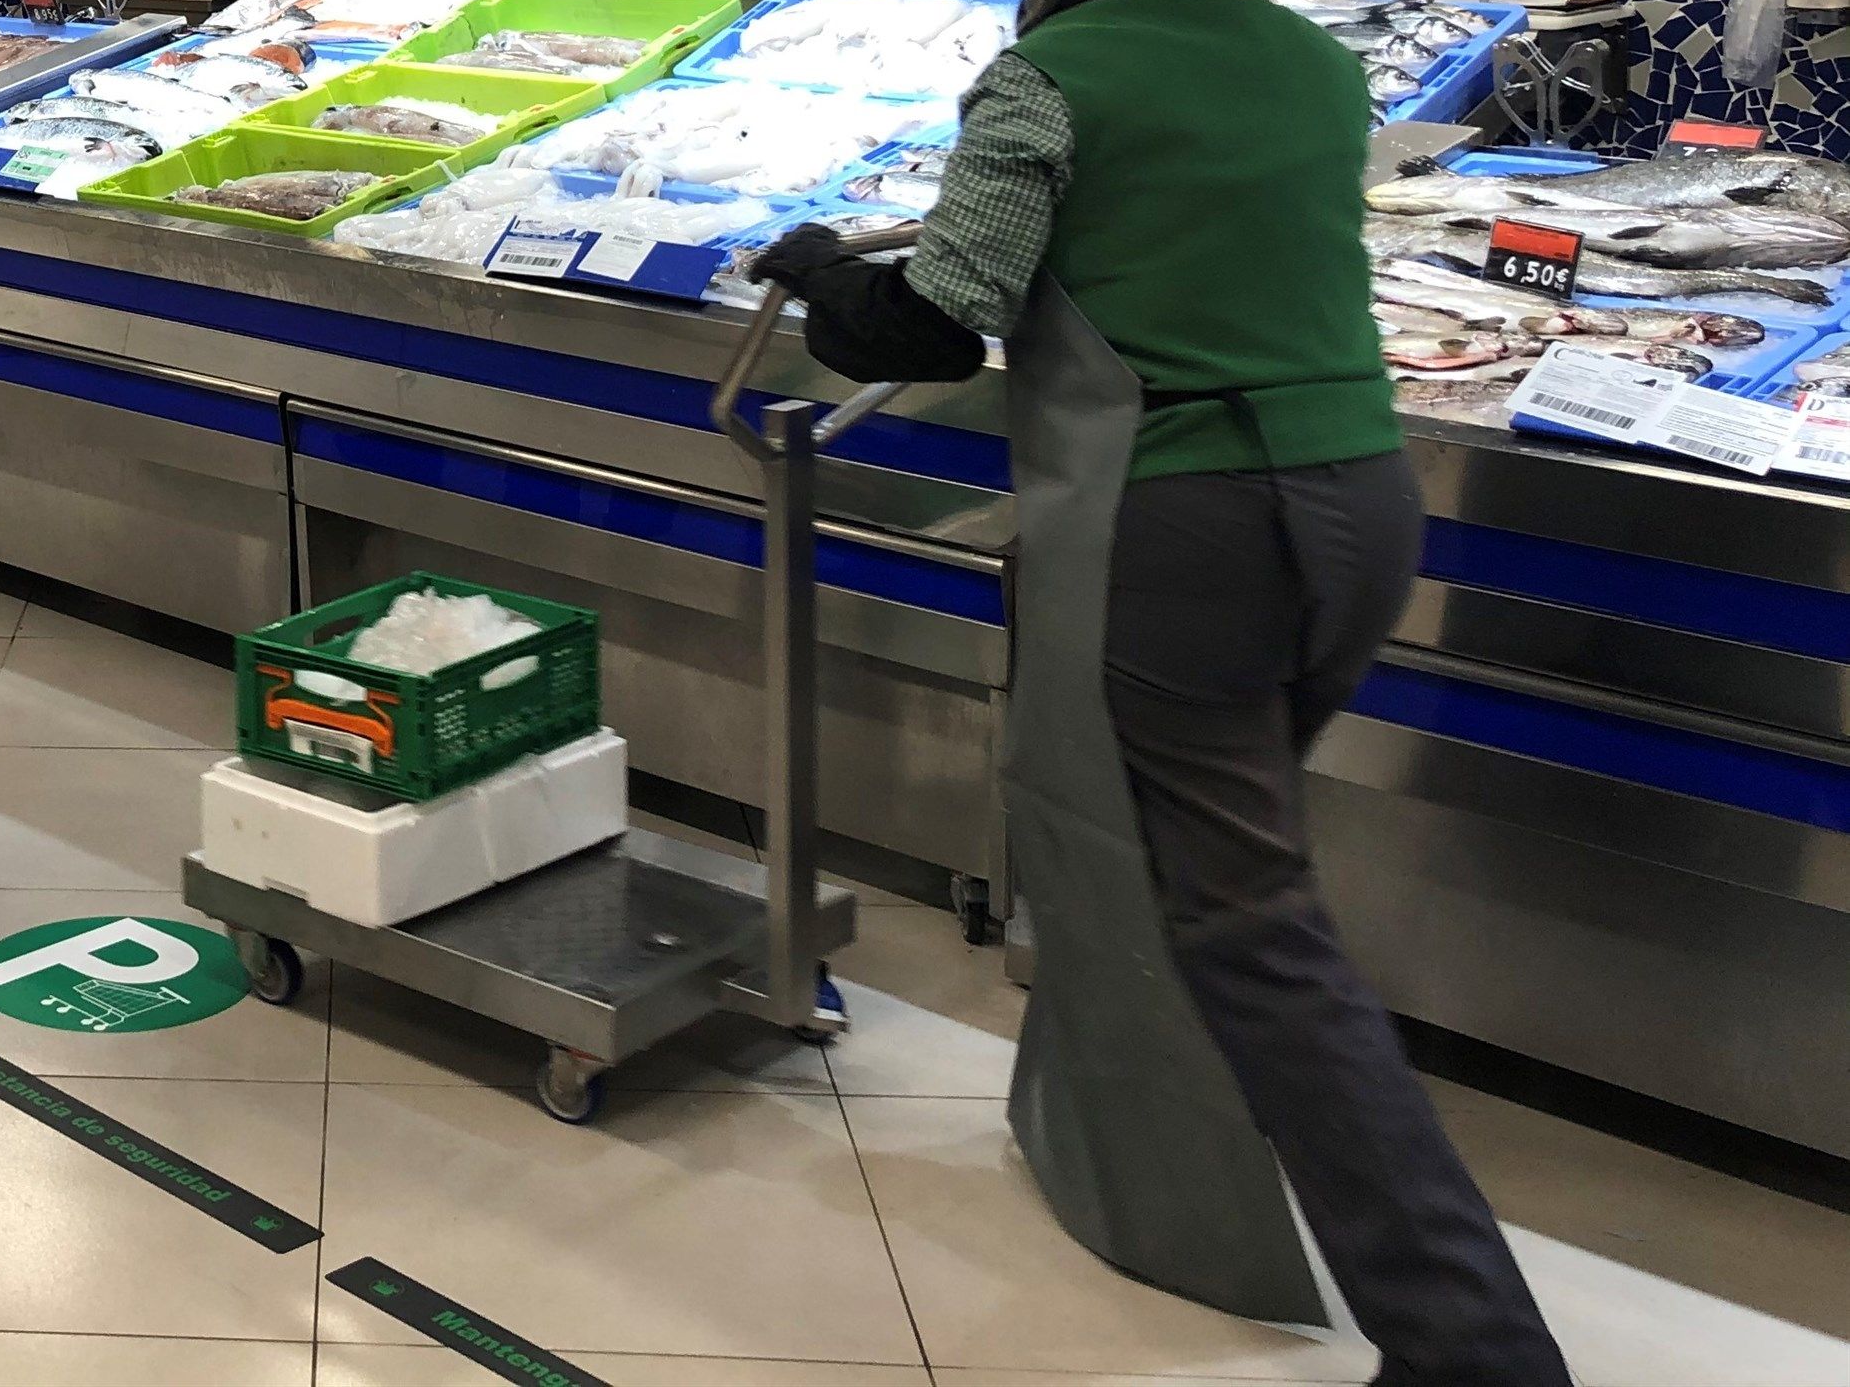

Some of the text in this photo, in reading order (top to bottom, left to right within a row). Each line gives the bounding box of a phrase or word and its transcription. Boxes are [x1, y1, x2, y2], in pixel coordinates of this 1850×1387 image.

[1503, 256, 1569, 287] 6,50€
[71, 1116, 105, 1136] de
[103, 1134, 232, 1203] seguridad
[430, 1309, 582, 1387] Manteng
